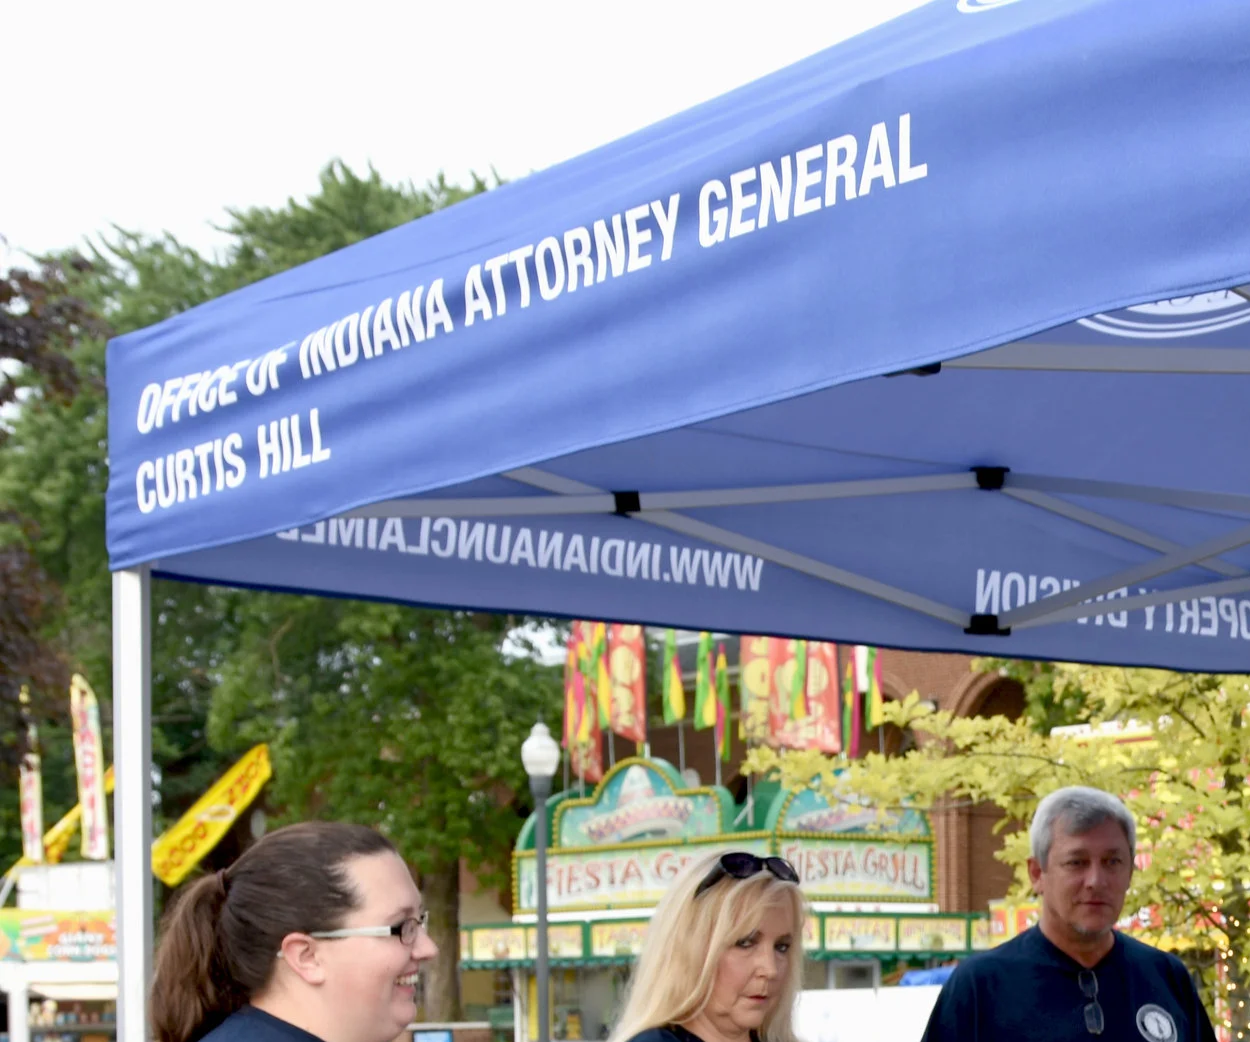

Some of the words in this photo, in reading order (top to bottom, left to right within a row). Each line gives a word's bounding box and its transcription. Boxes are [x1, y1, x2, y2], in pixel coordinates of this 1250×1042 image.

[137, 359, 250, 434] OFFICE
[246, 340, 298, 396] OF
[299, 278, 453, 379] INDIANA
[464, 192, 680, 327] ATTORNEY
[699, 113, 927, 248] GENERAL
[135, 432, 247, 514] CURTIS
[257, 407, 331, 479] HILL
